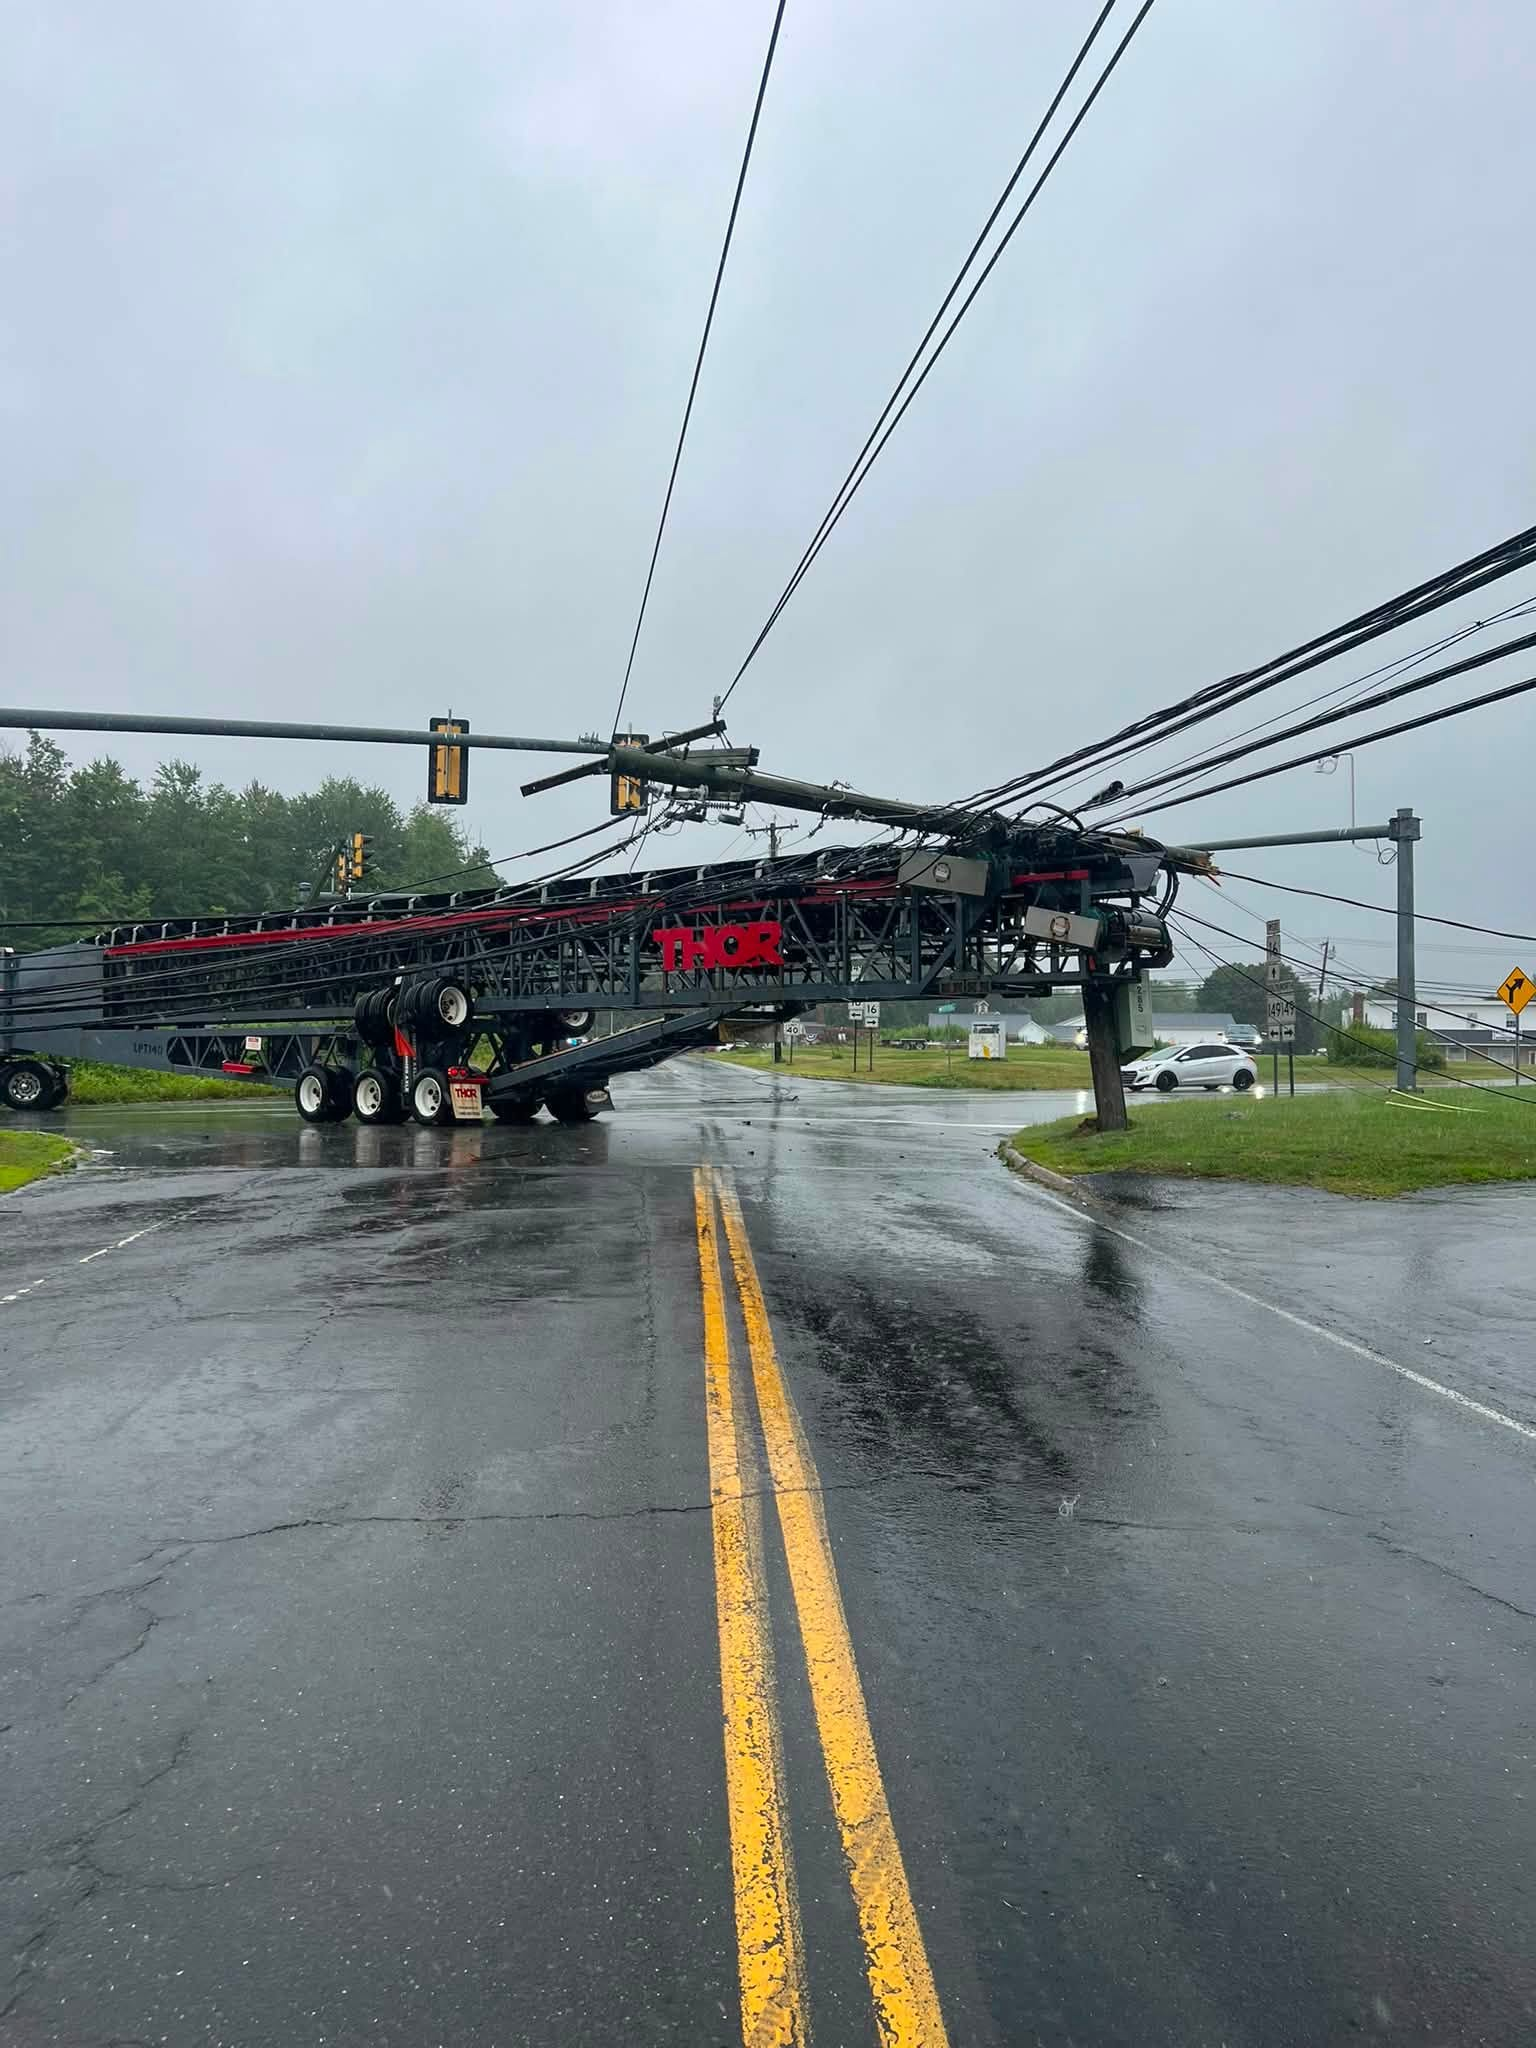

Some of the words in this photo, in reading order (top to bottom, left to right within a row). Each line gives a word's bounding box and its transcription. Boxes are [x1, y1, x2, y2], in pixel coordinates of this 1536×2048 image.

[653, 920, 784, 972] THOR
[867, 1004, 877, 1014] 16
[1268, 1002, 1281, 1017] 149
[786, 1026, 799, 1034] 40
[455, 1088, 477, 1098] THOR
